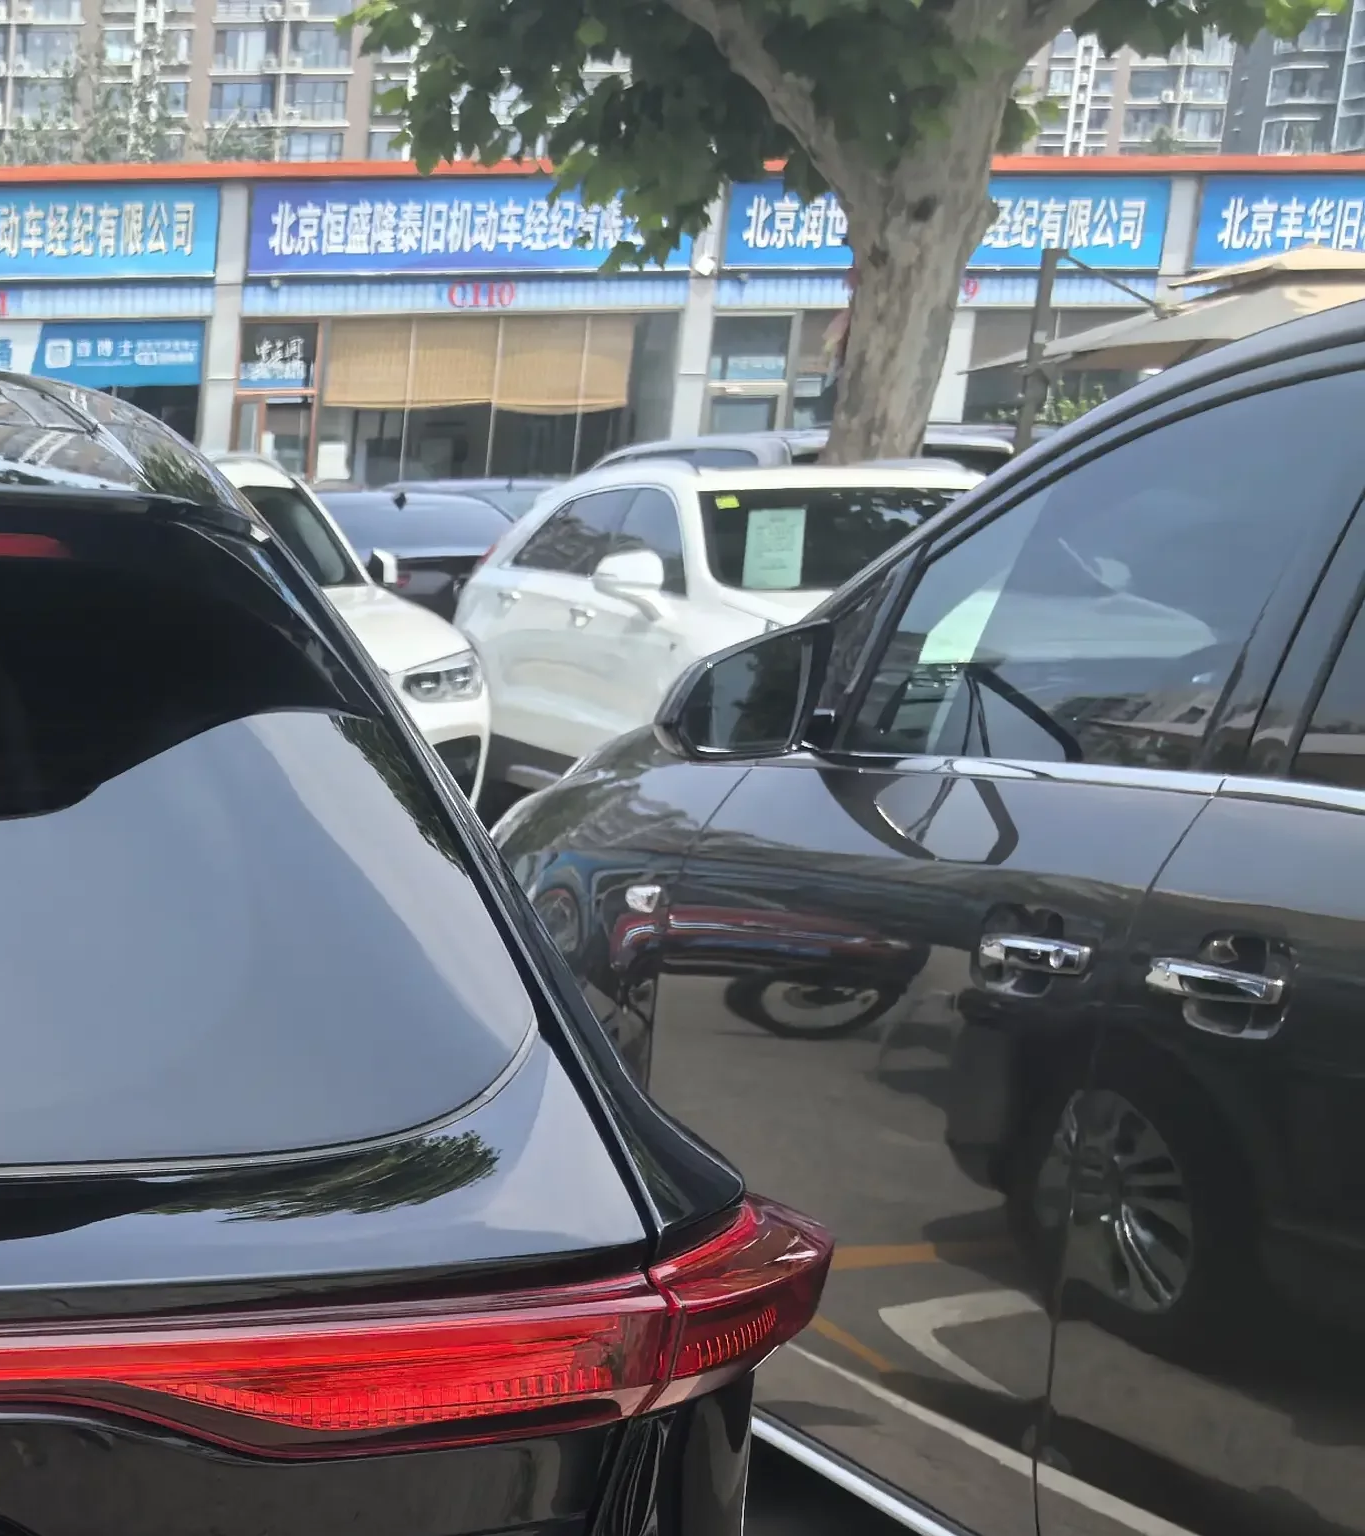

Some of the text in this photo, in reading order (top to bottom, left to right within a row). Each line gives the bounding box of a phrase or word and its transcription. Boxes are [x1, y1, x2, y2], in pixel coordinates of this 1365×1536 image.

[1217, 195, 1365, 251] 北京丰华旧
[447, 281, 517, 308] C110
